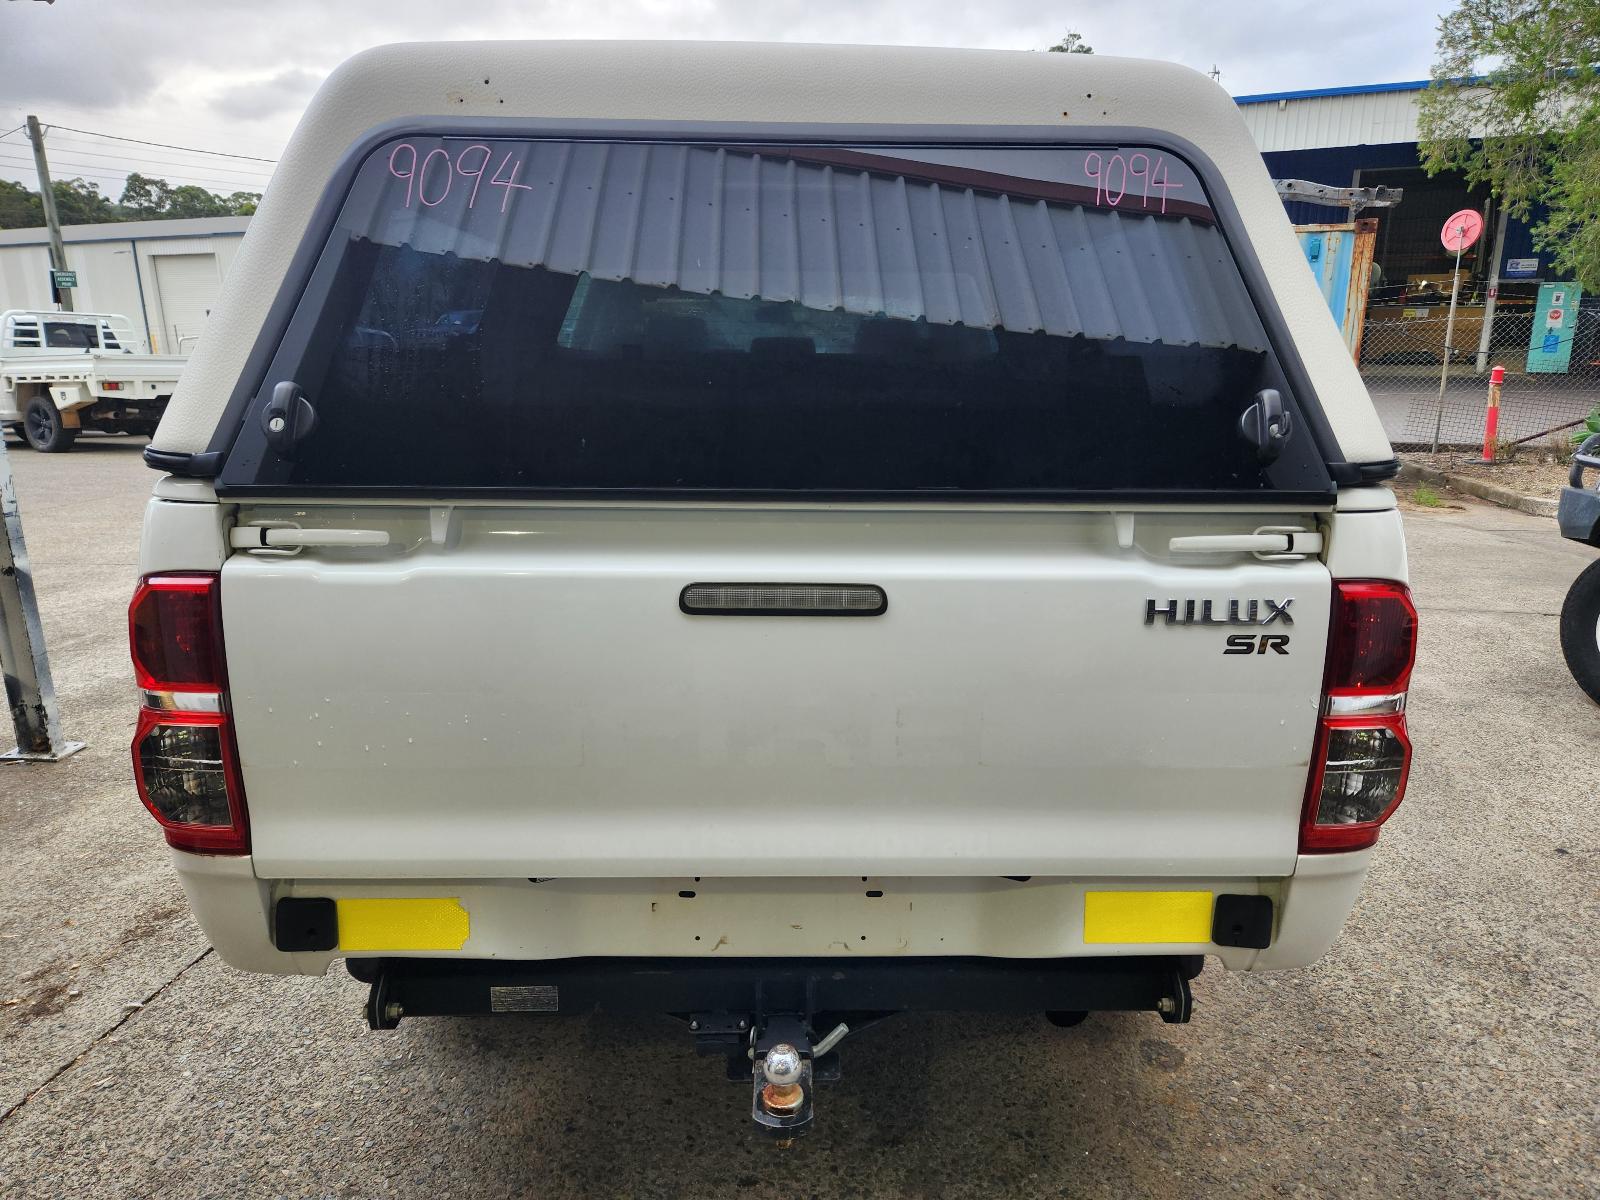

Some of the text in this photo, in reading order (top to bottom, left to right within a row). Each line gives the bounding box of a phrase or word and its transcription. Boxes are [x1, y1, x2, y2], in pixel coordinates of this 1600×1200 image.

[389, 143, 533, 213] 9094
[1084, 152, 1184, 214] 9094
[1144, 597, 1295, 626] HILUX
[1222, 634, 1290, 655] SR
